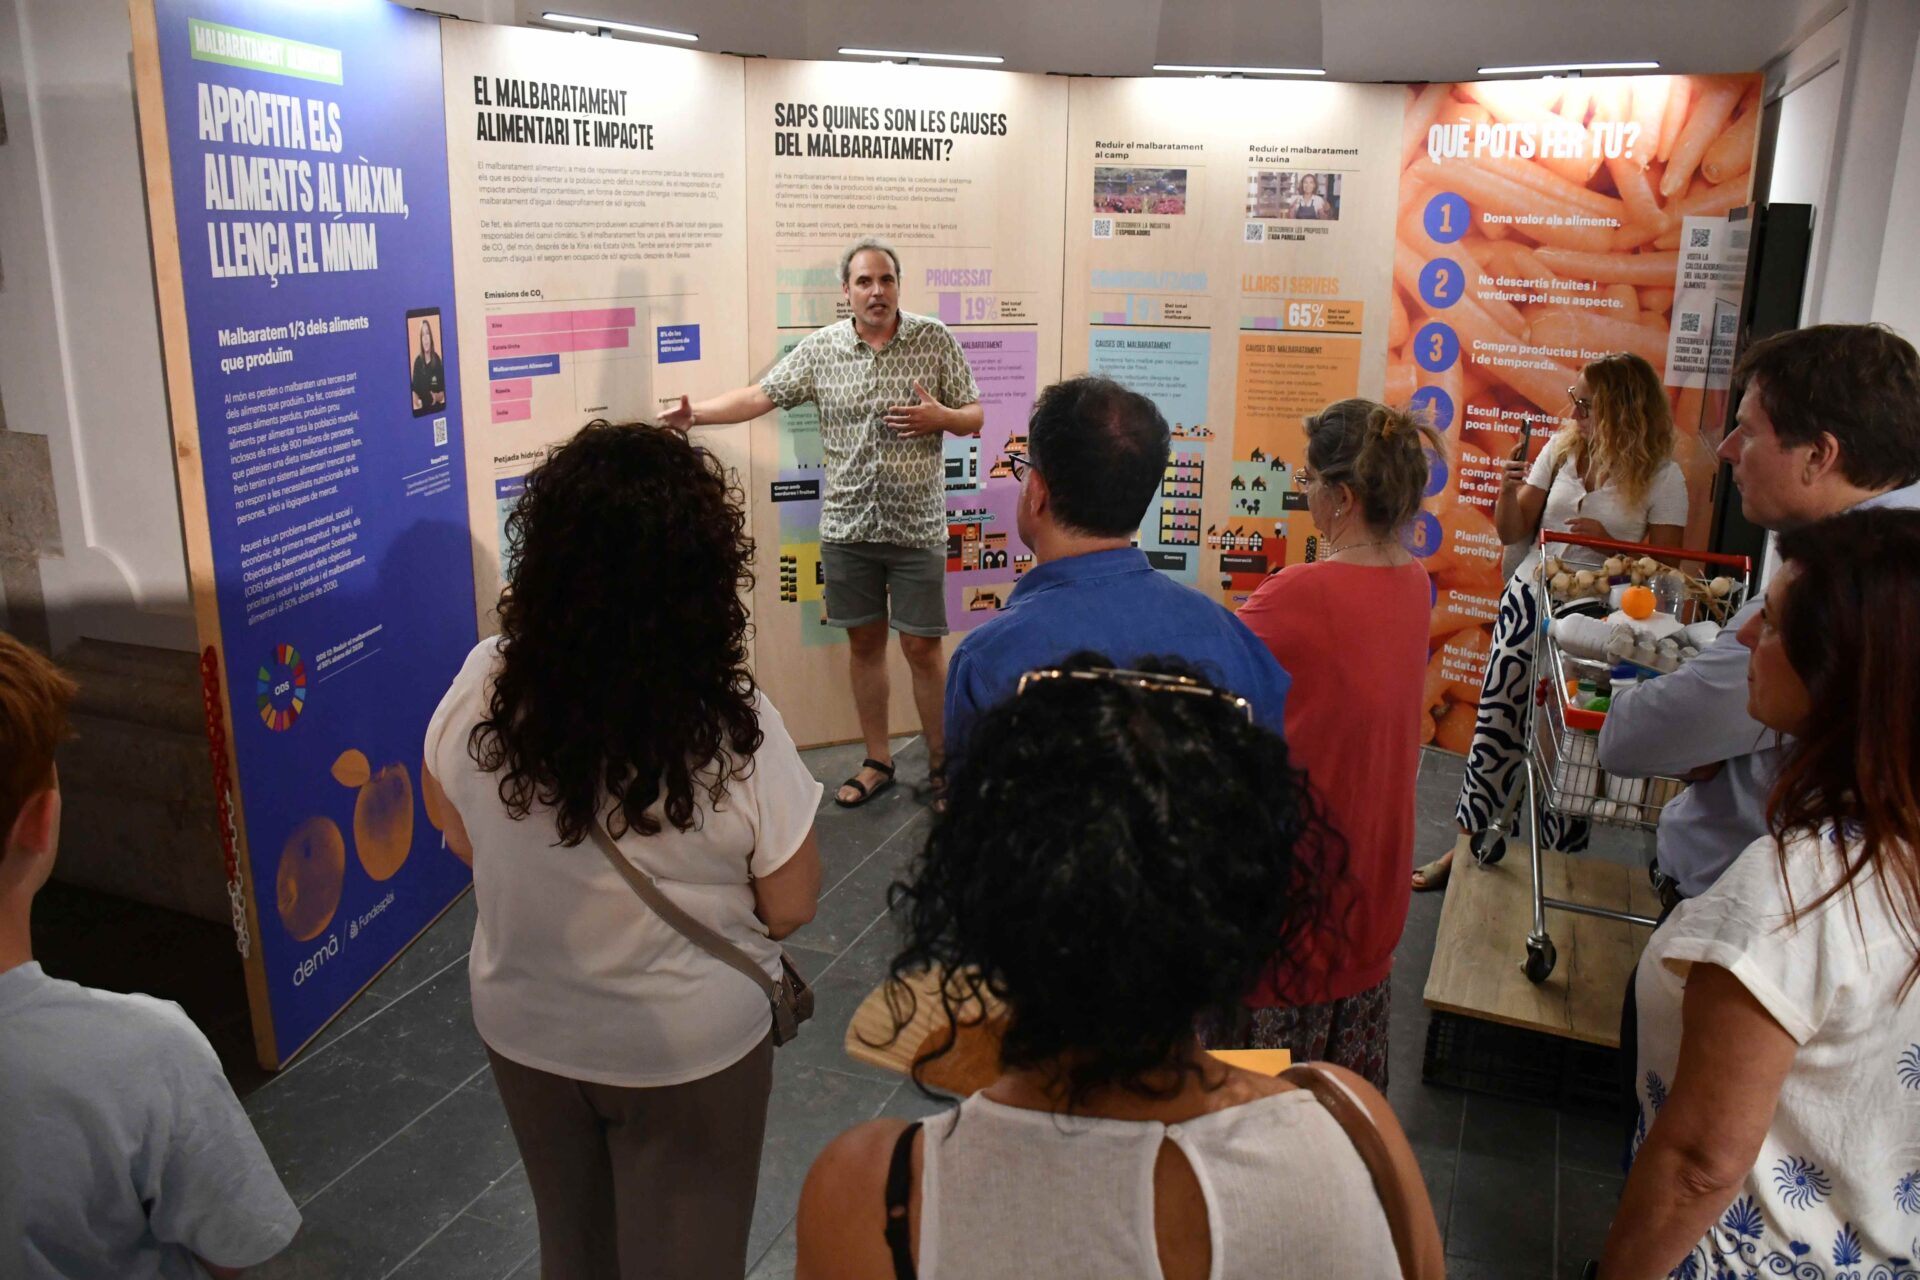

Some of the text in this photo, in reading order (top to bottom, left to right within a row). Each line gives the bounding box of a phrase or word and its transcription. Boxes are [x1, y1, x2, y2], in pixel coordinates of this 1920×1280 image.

[474, 76, 627, 116] EL MALBARATAMENT
[198, 83, 342, 153] APROFITA ELS
[775, 102, 817, 128] SAPS
[823, 105, 879, 132] QUINES
[921, 110, 945, 133] LES
[950, 112, 1007, 135] CAUSES
[477, 112, 653, 150] ALIMENTARI TÉ IMPACTE
[775, 133, 953, 161] DEL MALBARATAMENT?
[1136, 142, 1203, 150] malbaratament
[1427, 117, 1641, 164] QUÈ POTS FER TU?
[1290, 146, 1358, 154] malbaratament
[204, 153, 408, 219] ALIMENTS AL MÀXIM,
[1439, 203, 1452, 233] 1
[1483, 213, 1620, 226] Dona valor als aliments.
[208, 215, 378, 288] LLENÇA EL MÍNIM
[926, 268, 992, 286] PROCESSAT
[1242, 274, 1280, 292] LLARS
[1290, 277, 1340, 295] SERVEIS
[1434, 269, 1448, 298] 2
[1479, 274, 1596, 292] No descartis fruites i
[965, 297, 998, 320] 19%
[1477, 291, 1623, 308] verdures pel seu aspecte.
[1288, 303, 1324, 327] 65%
[218, 316, 369, 347] Malbaratem 1/3 dels aliments
[1429, 334, 1443, 361] 3
[1473, 340, 1612, 360] Compra productes loca
[221, 347, 293, 374] que produïm
[1472, 352, 1557, 370] i de temporada.
[1467, 405, 1559, 424] Escull productes
[1466, 421, 1491, 430] pocs
[494, 454, 519, 462] Petjada
[1462, 452, 1490, 465] No et
[1461, 468, 1502, 480] compra
[1460, 479, 1475, 490] les
[1458, 495, 1493, 505] potser
[1414, 520, 1427, 548] 6
[1455, 530, 1501, 546] Planifica
[1454, 545, 1500, 559] aprofitar
[1449, 590, 1499, 607] Conserva
[1448, 604, 1463, 614] els
[1444, 644, 1490, 661] No llenci
[1442, 657, 1476, 671] la data
[1441, 670, 1482, 686] fixa't en
[274, 680, 290, 696] ODS
[292, 893, 395, 986] demà Fundesplai
